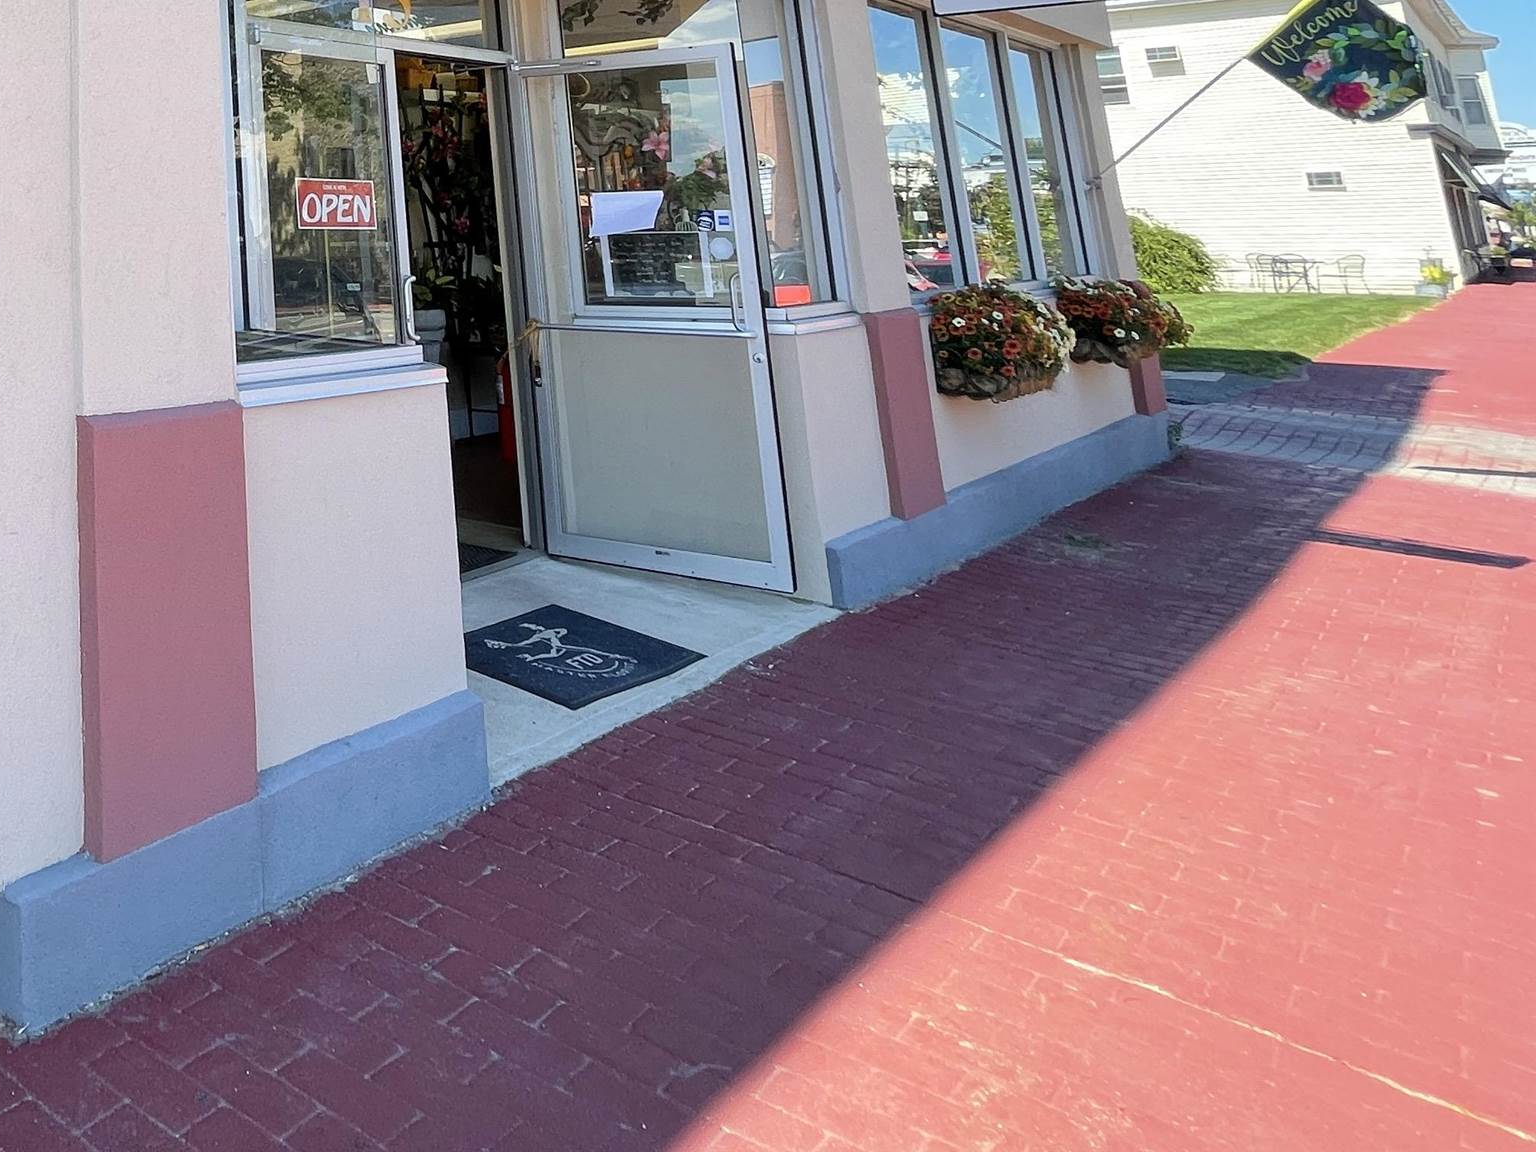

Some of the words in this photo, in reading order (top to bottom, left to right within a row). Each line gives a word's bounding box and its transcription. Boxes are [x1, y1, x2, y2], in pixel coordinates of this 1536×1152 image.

[1261, 0, 1359, 66] Welcome
[302, 192, 370, 223] OPEN
[565, 653, 603, 669] FTD
